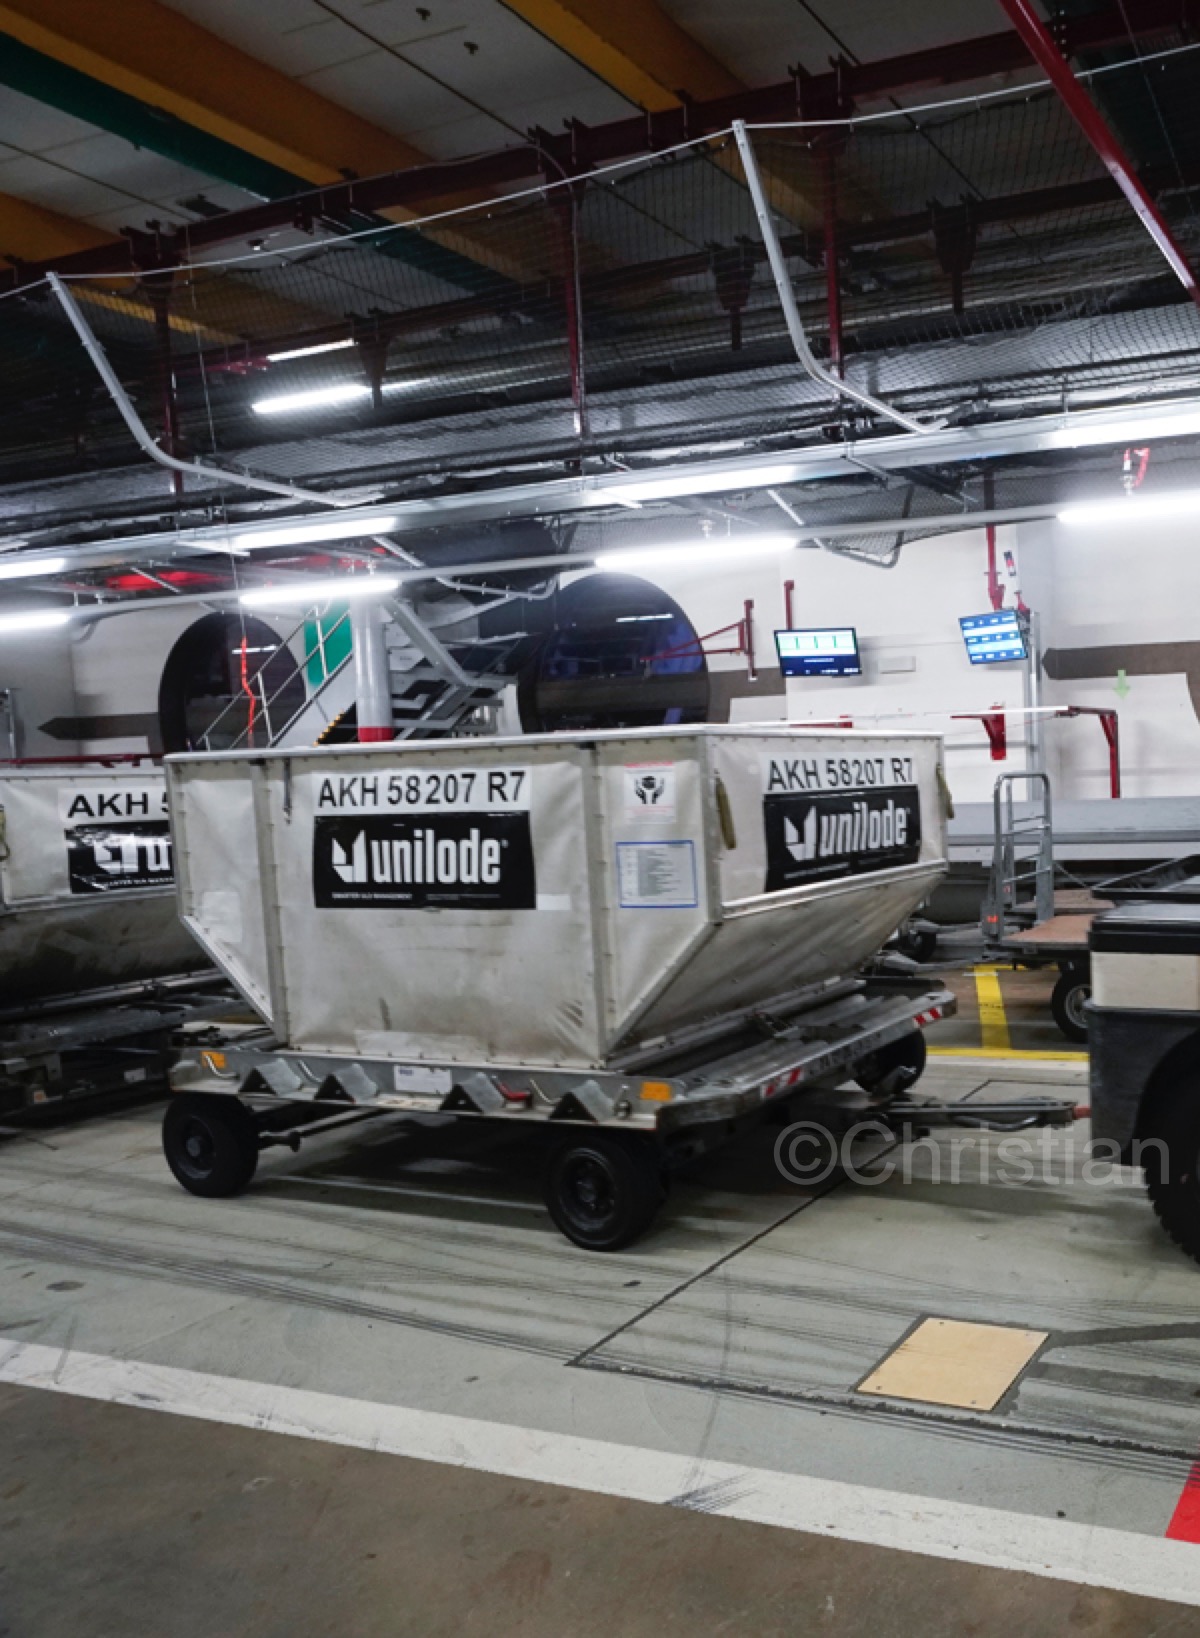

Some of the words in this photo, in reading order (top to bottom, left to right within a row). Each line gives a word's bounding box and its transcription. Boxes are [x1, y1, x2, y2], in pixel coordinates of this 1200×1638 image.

[317, 776, 379, 808] AKH
[387, 773, 477, 806] 58207
[487, 770, 526, 803] R7
[768, 758, 821, 790] AKH
[825, 757, 885, 787] 58207
[891, 757, 913, 784] R7
[67, 791, 149, 818] AKH
[818, 799, 908, 858] unilode
[370, 828, 502, 884] unilode
